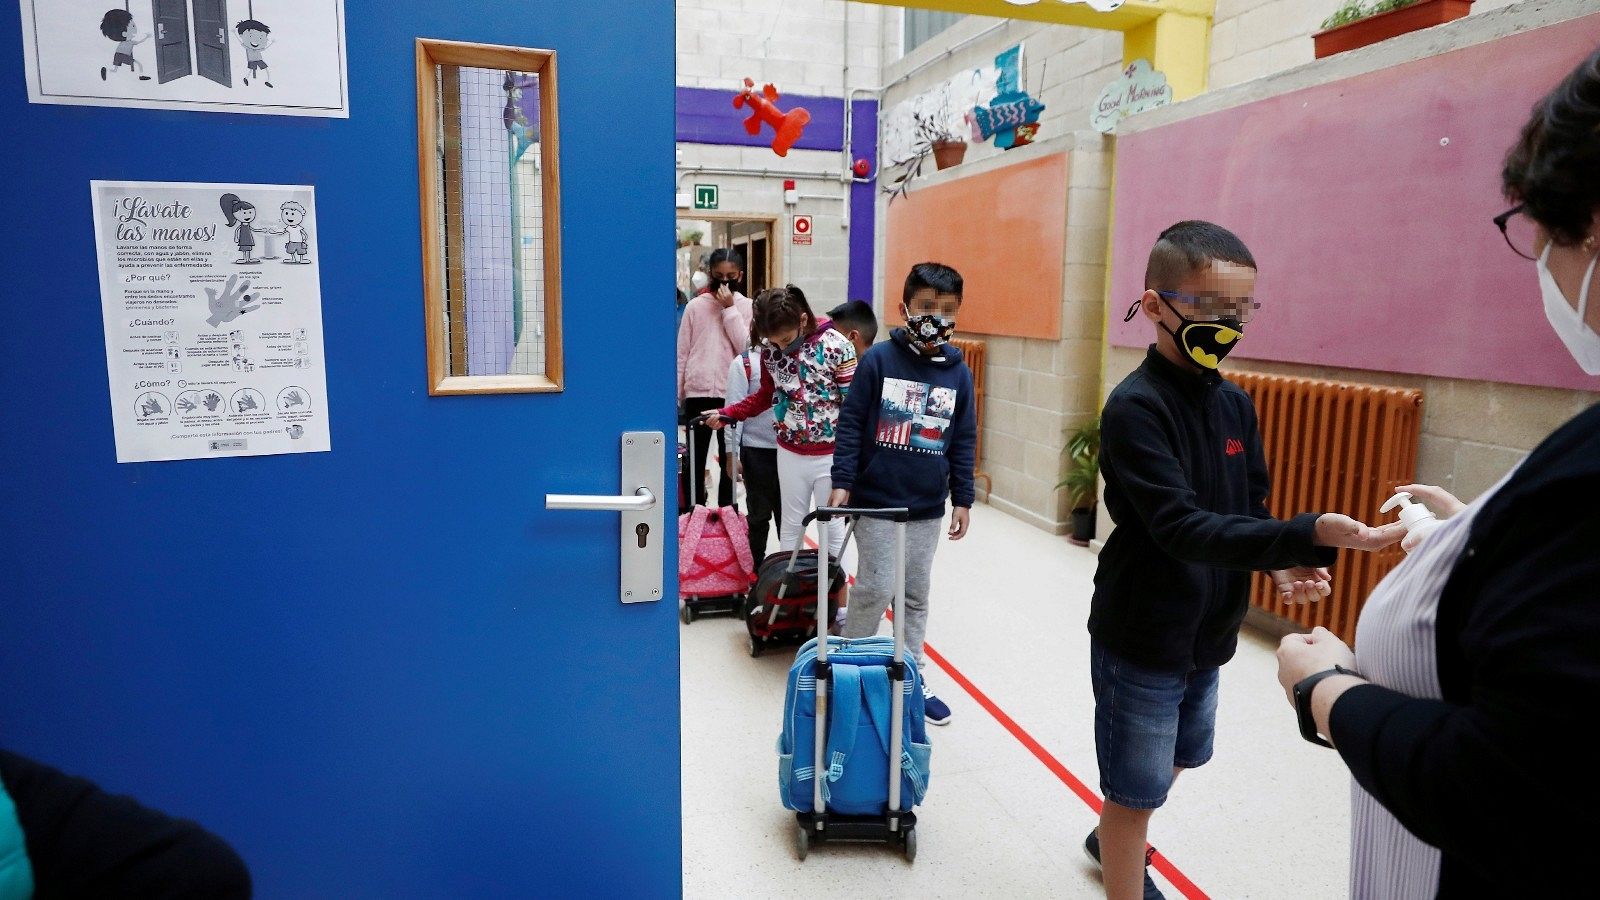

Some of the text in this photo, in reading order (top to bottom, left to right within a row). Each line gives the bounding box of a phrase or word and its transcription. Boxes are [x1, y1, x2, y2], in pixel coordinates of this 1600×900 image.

[114, 196, 192, 227] ¡Lávate
[116, 223, 217, 242] las manos!
[125, 273, 171, 283] ¿Por qué?
[129, 318, 175, 328] ¿Cuándo?
[134, 379, 171, 389] ¿Cómo?
